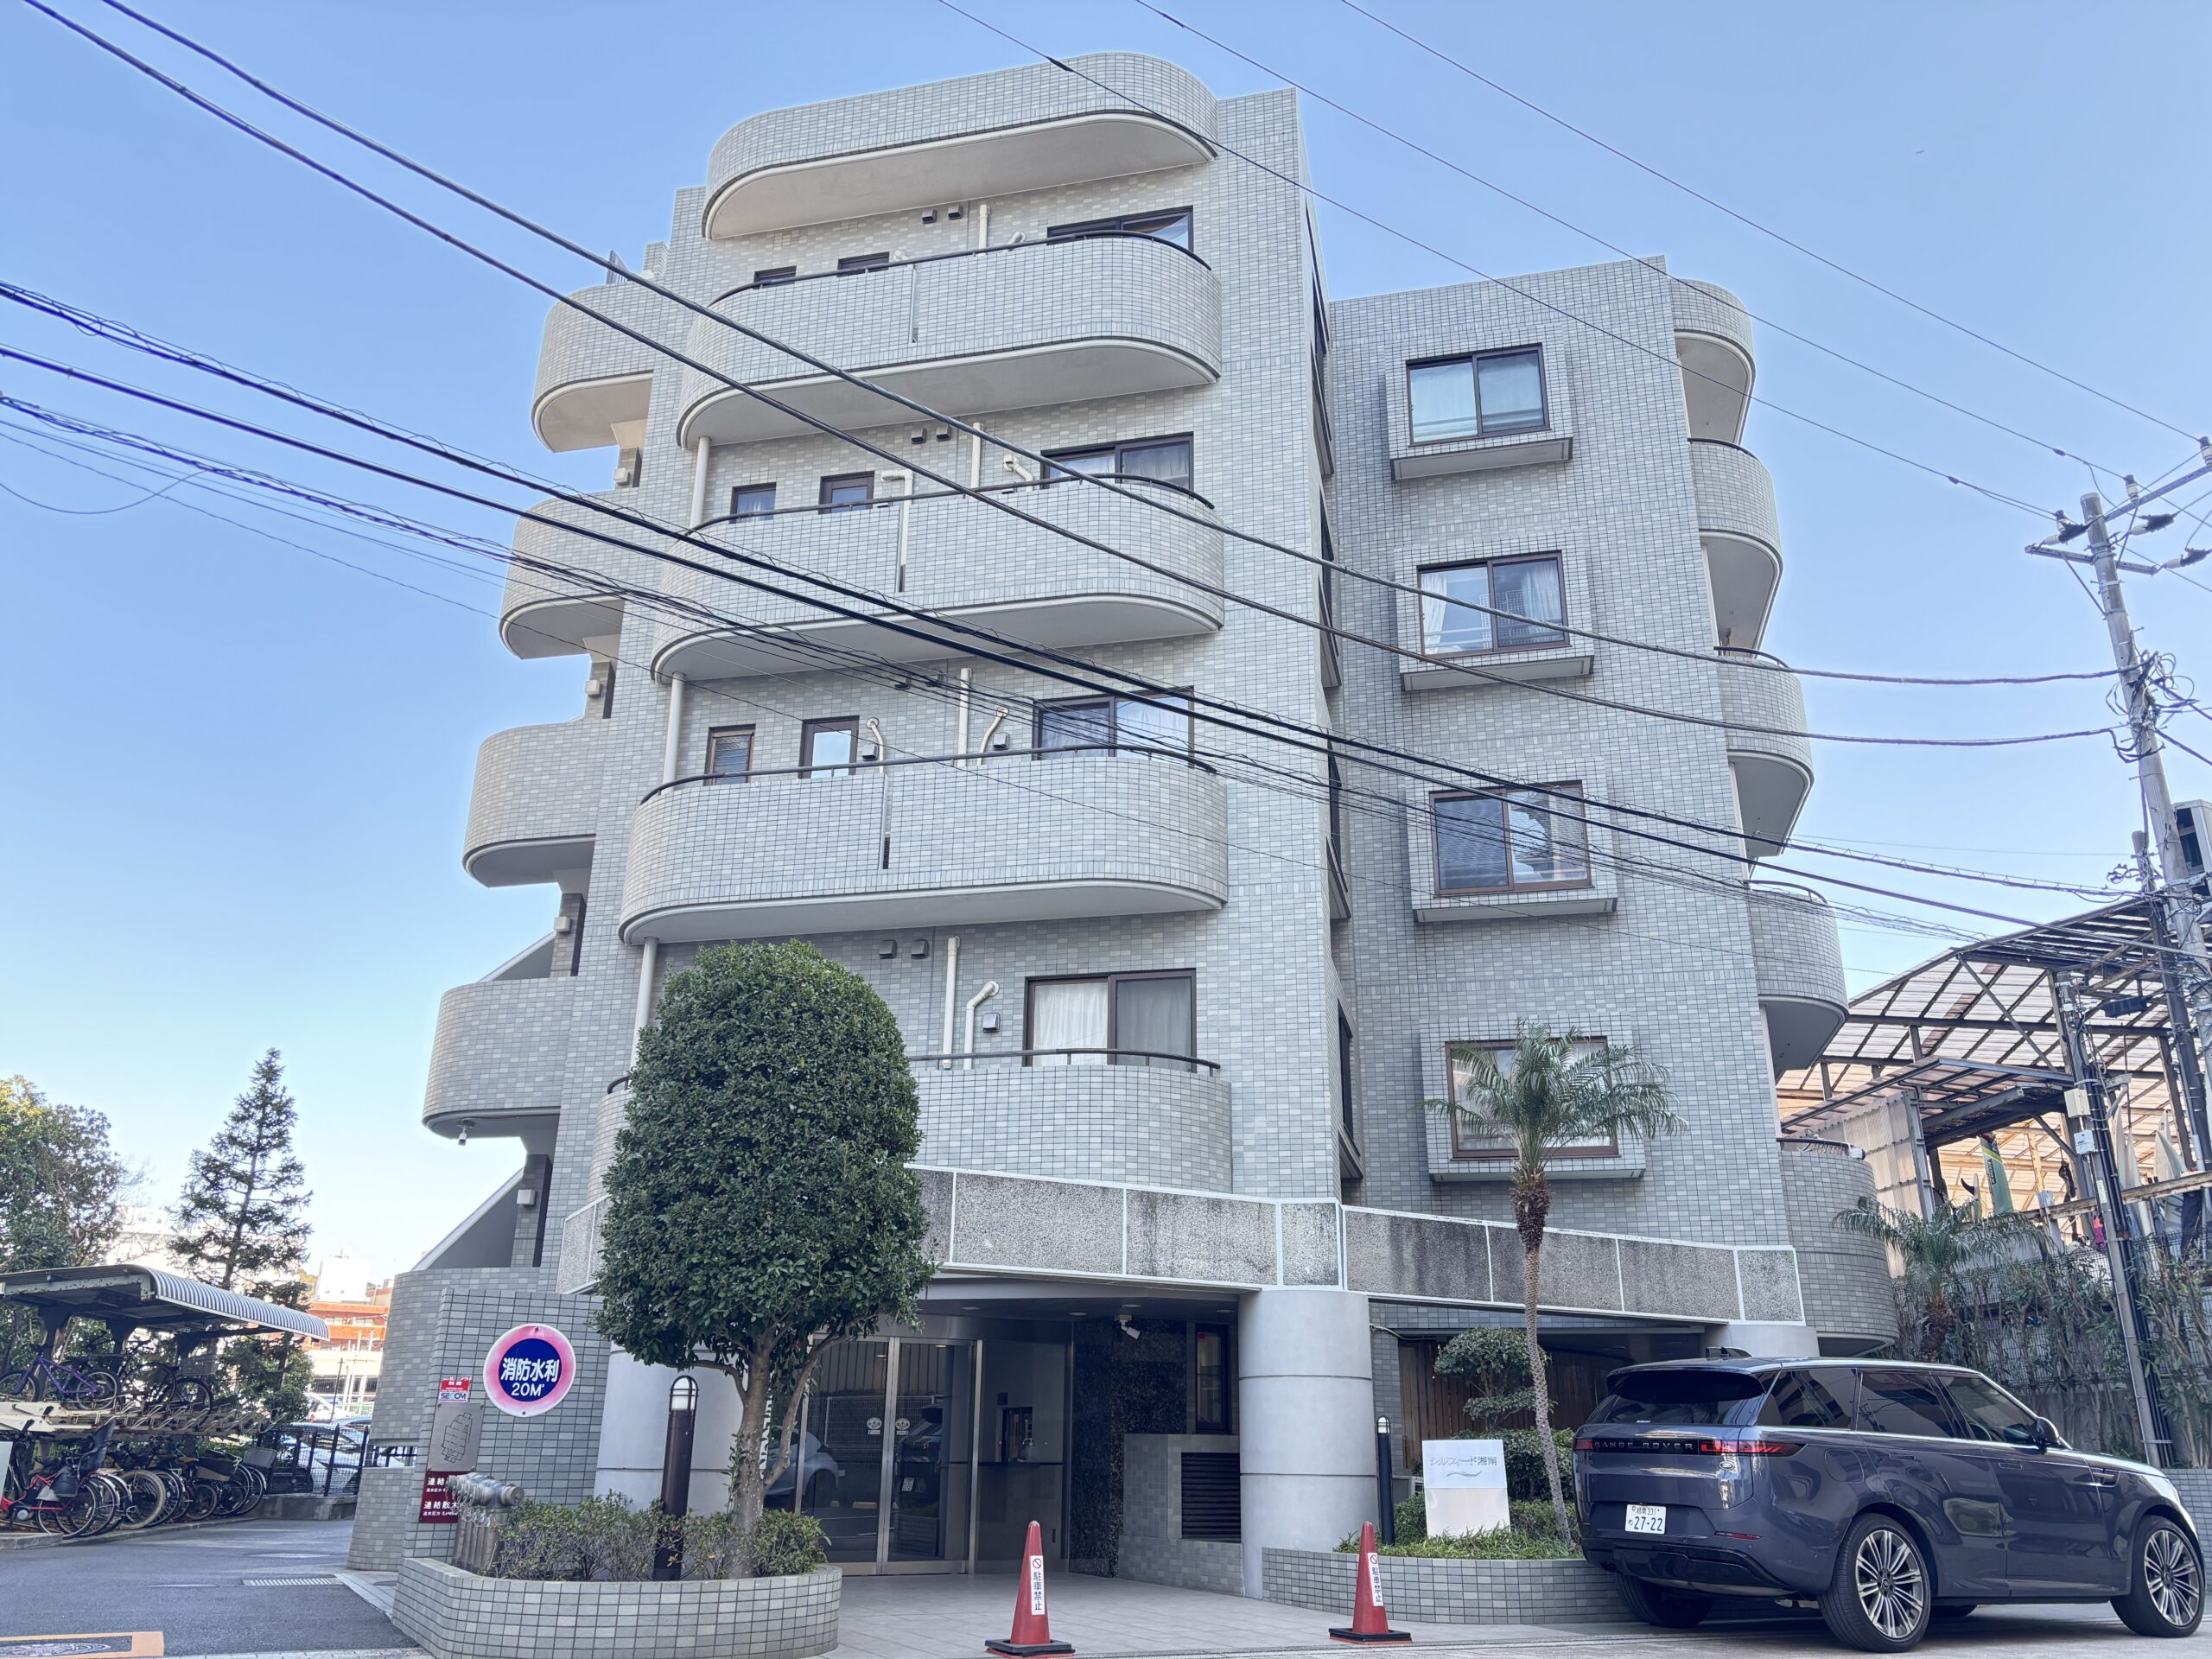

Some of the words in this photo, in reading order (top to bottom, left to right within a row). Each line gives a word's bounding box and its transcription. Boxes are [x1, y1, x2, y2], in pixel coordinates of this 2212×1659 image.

[501, 1357, 560, 1382] 消防水利
[1643, 1442, 1694, 1451] ROVER
[1430, 1456, 1497, 1466] シルフィード湘南
[1634, 1516, 1663, 1532] 27-22
[1033, 1571, 1043, 1611] 駐車禁止
[1372, 1567, 1382, 1603] 駐車禁止
